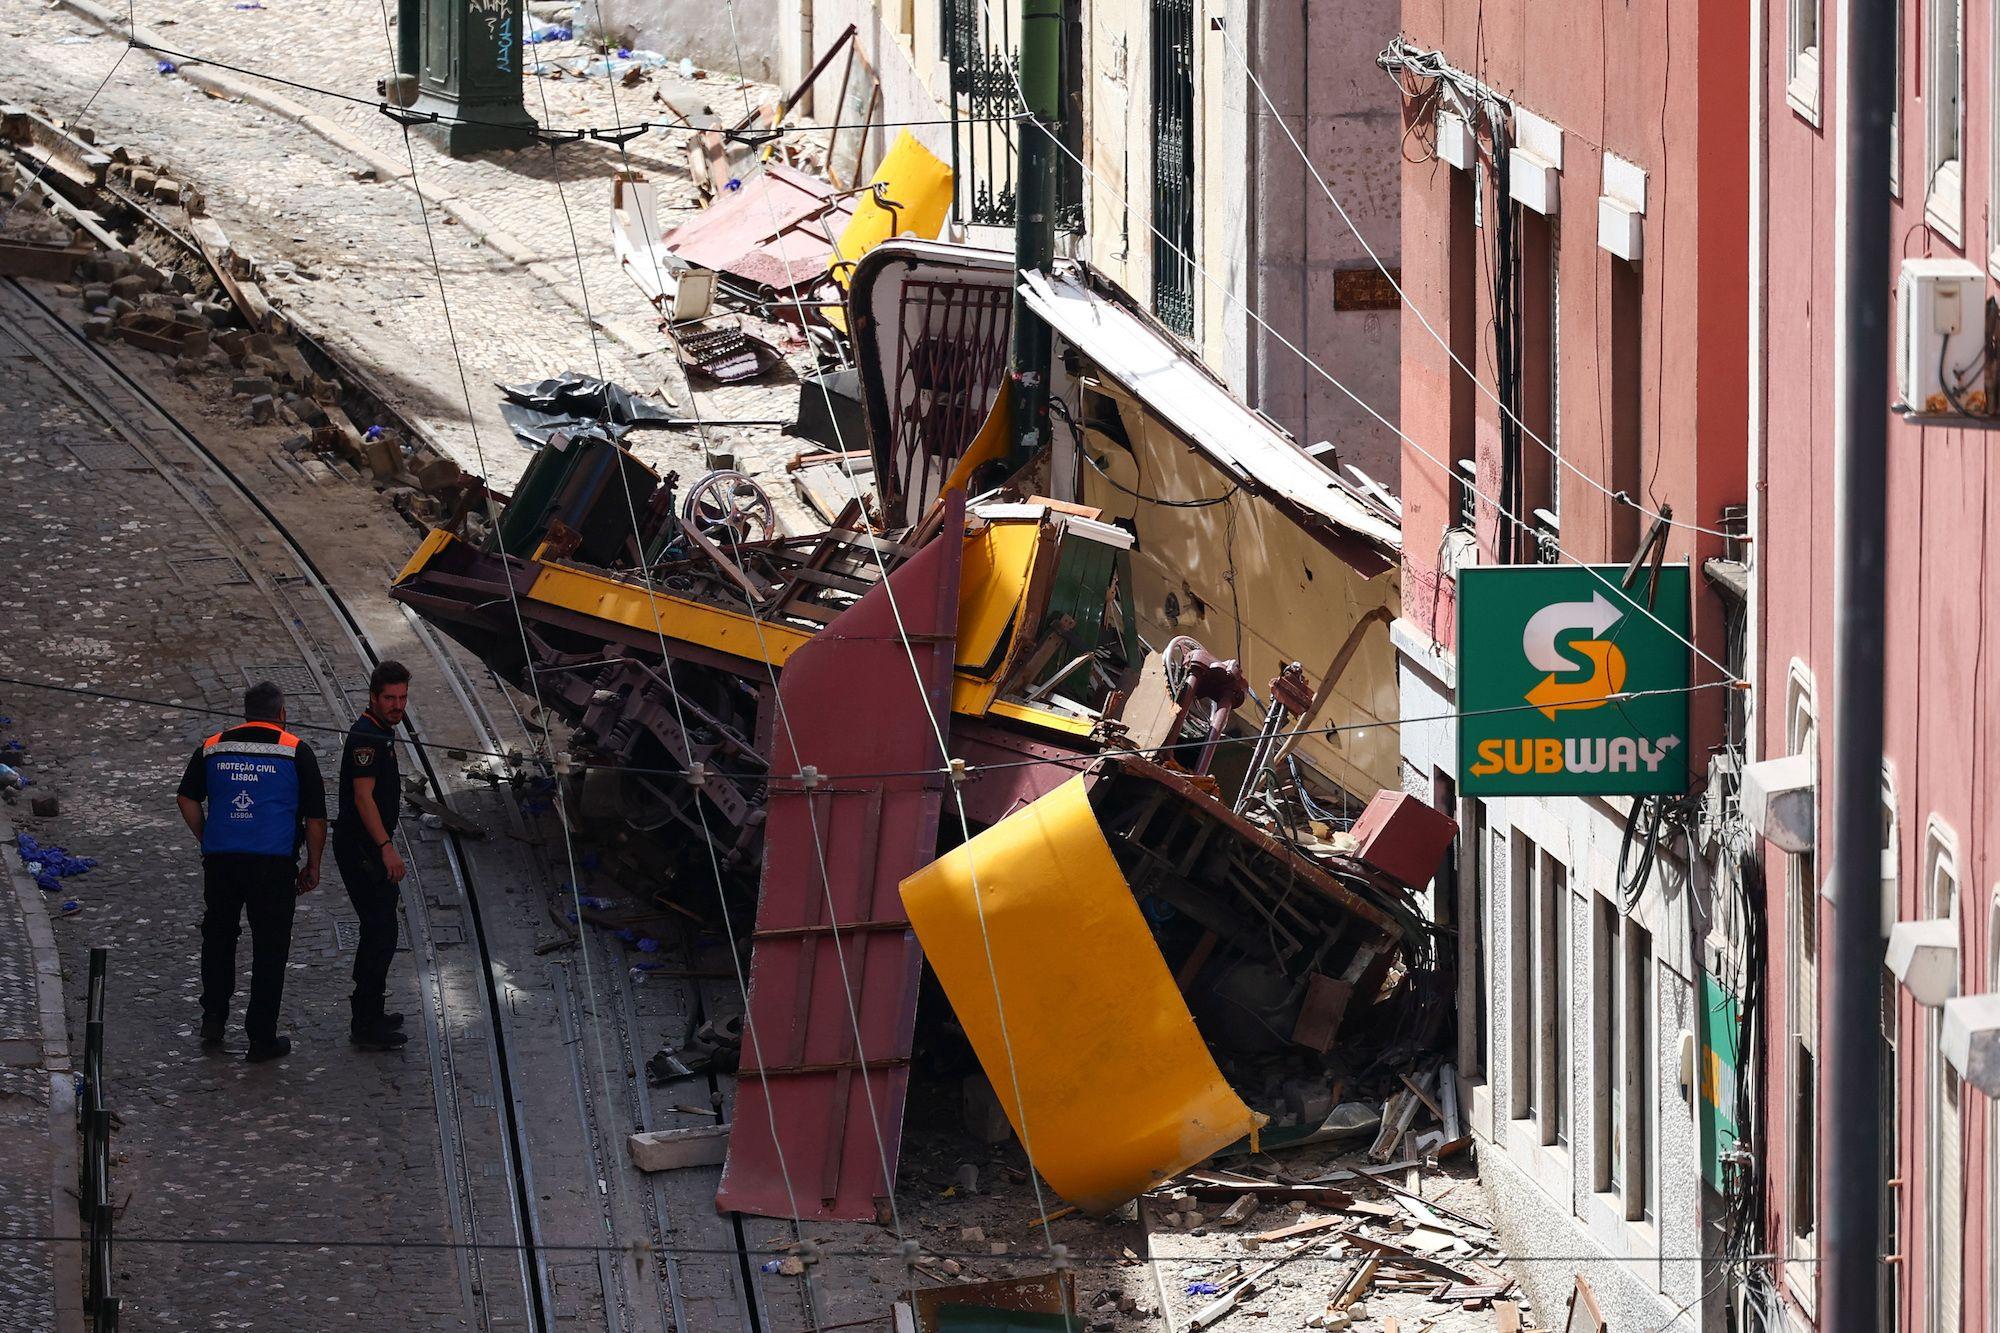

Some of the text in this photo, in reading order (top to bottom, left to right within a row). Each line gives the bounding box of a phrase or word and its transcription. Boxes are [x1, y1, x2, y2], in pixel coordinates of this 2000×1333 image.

[1469, 733, 1681, 778] SUBWAY
[256, 765, 276, 773] CIVIL
[231, 773, 258, 782] LISBOA
